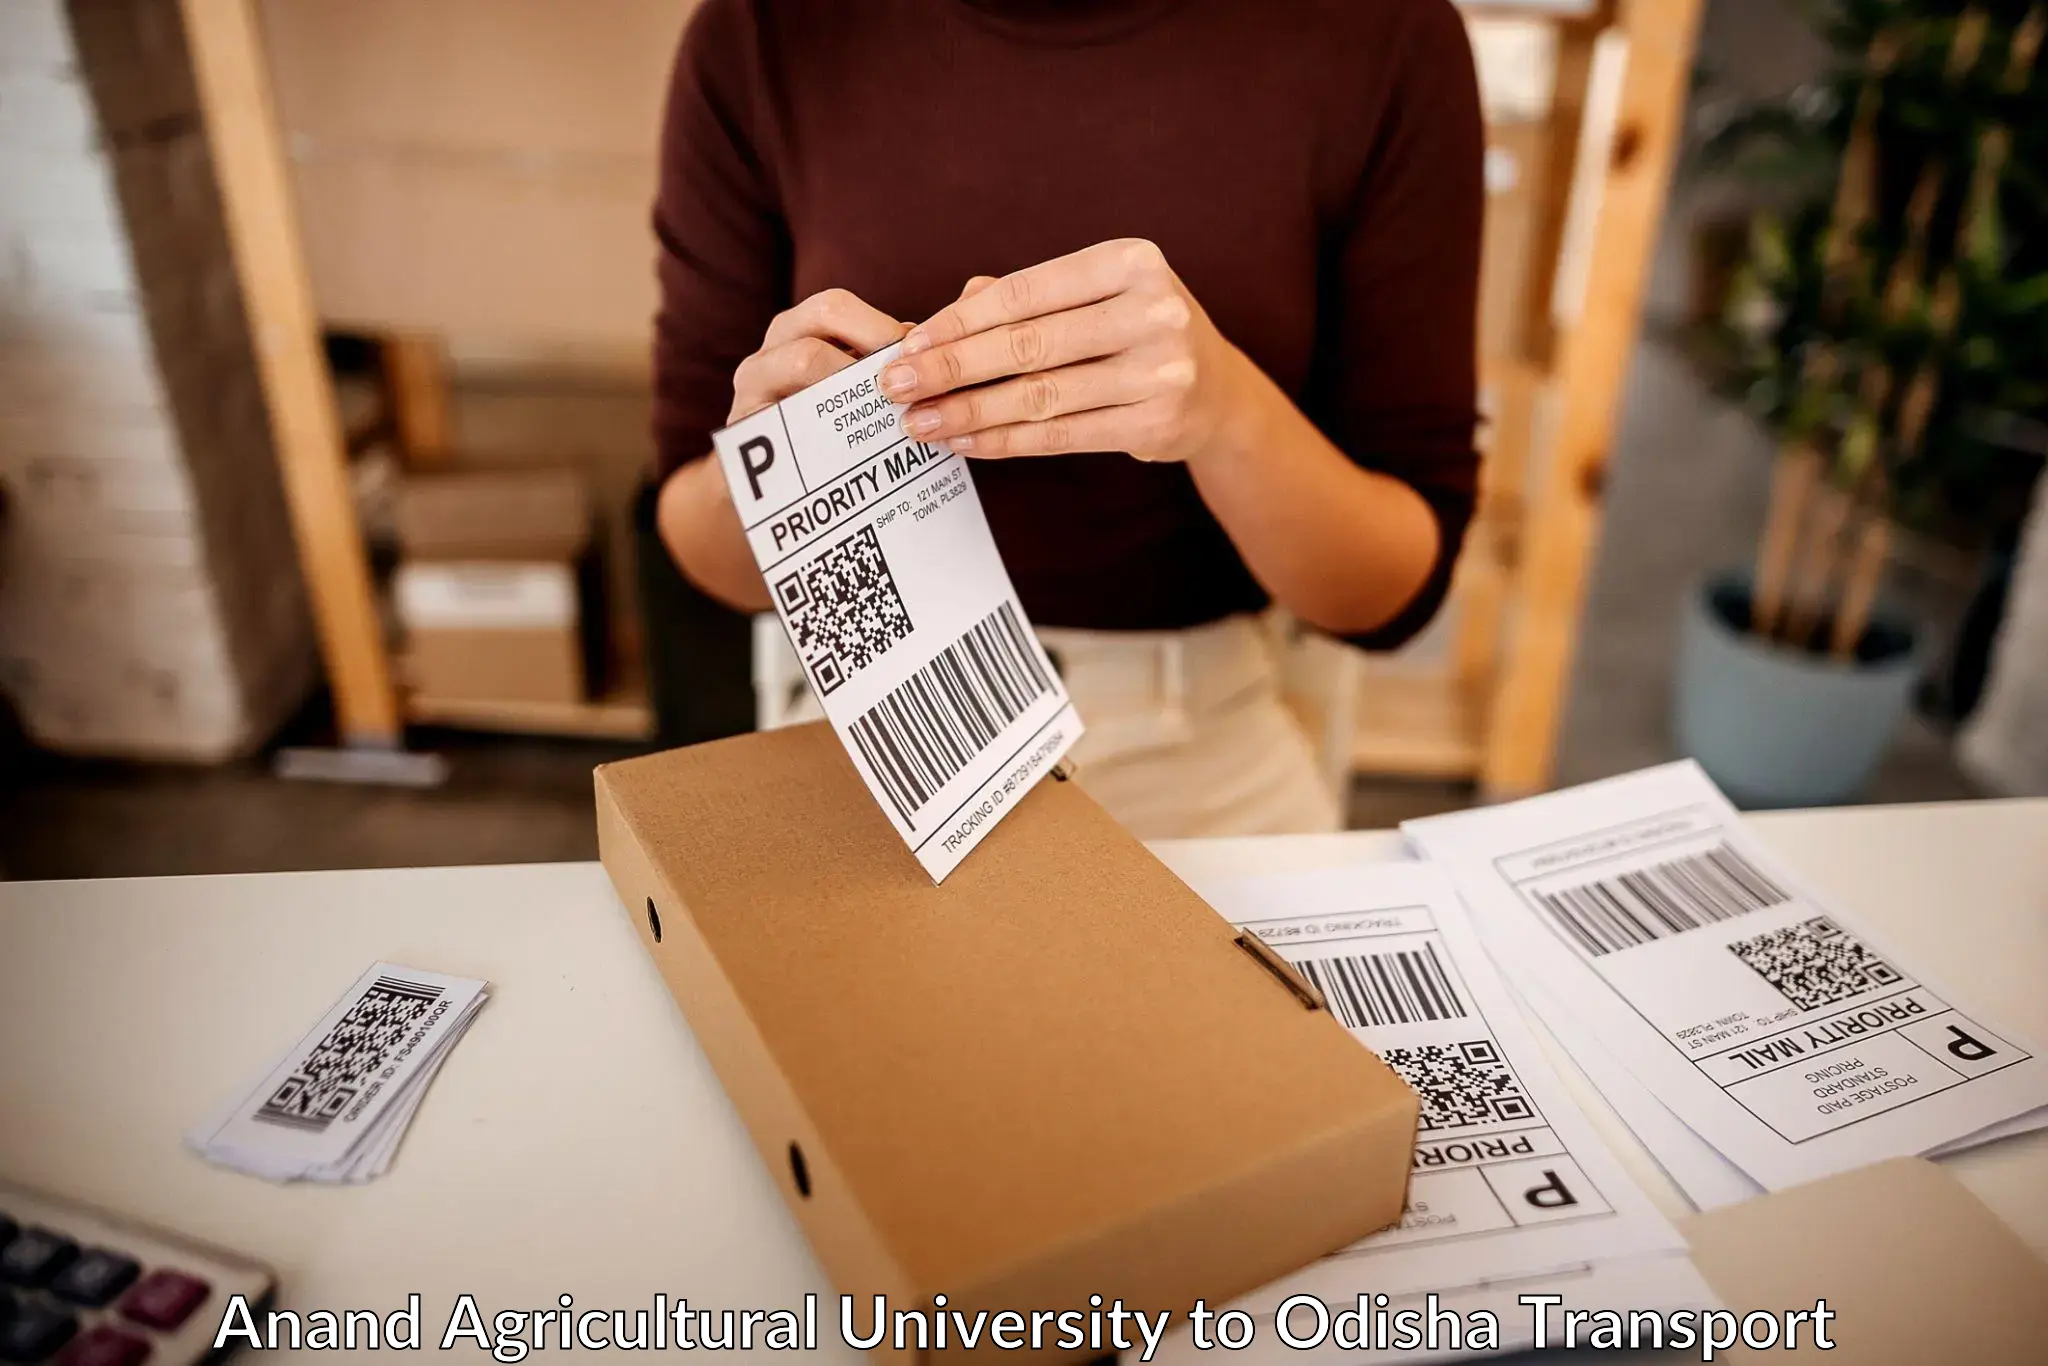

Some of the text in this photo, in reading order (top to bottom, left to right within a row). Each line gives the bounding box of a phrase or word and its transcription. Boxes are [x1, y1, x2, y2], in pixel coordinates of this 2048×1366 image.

[816, 378, 874, 418] POSTAGE
[834, 394, 894, 432] STANDAR
[846, 413, 895, 449] PRICING
[739, 435, 775, 500] P
[770, 465, 879, 551] PRIORITY
[876, 467, 963, 529] SHIP TO: 121 MAIN ST
[941, 801, 994, 853] TRACKING
[991, 790, 1004, 806] ID
[393, 1000, 453, 1062] FS490100QR
[1728, 997, 1926, 1070] PRIORITY MAIL
[1947, 1025, 1998, 1061] P
[1804, 1057, 1864, 1083] PRICING
[1813, 1067, 1888, 1098] STANDARD
[1817, 1073, 1918, 1115] POSTAGE PAID
[1523, 1169, 1579, 1208] P
